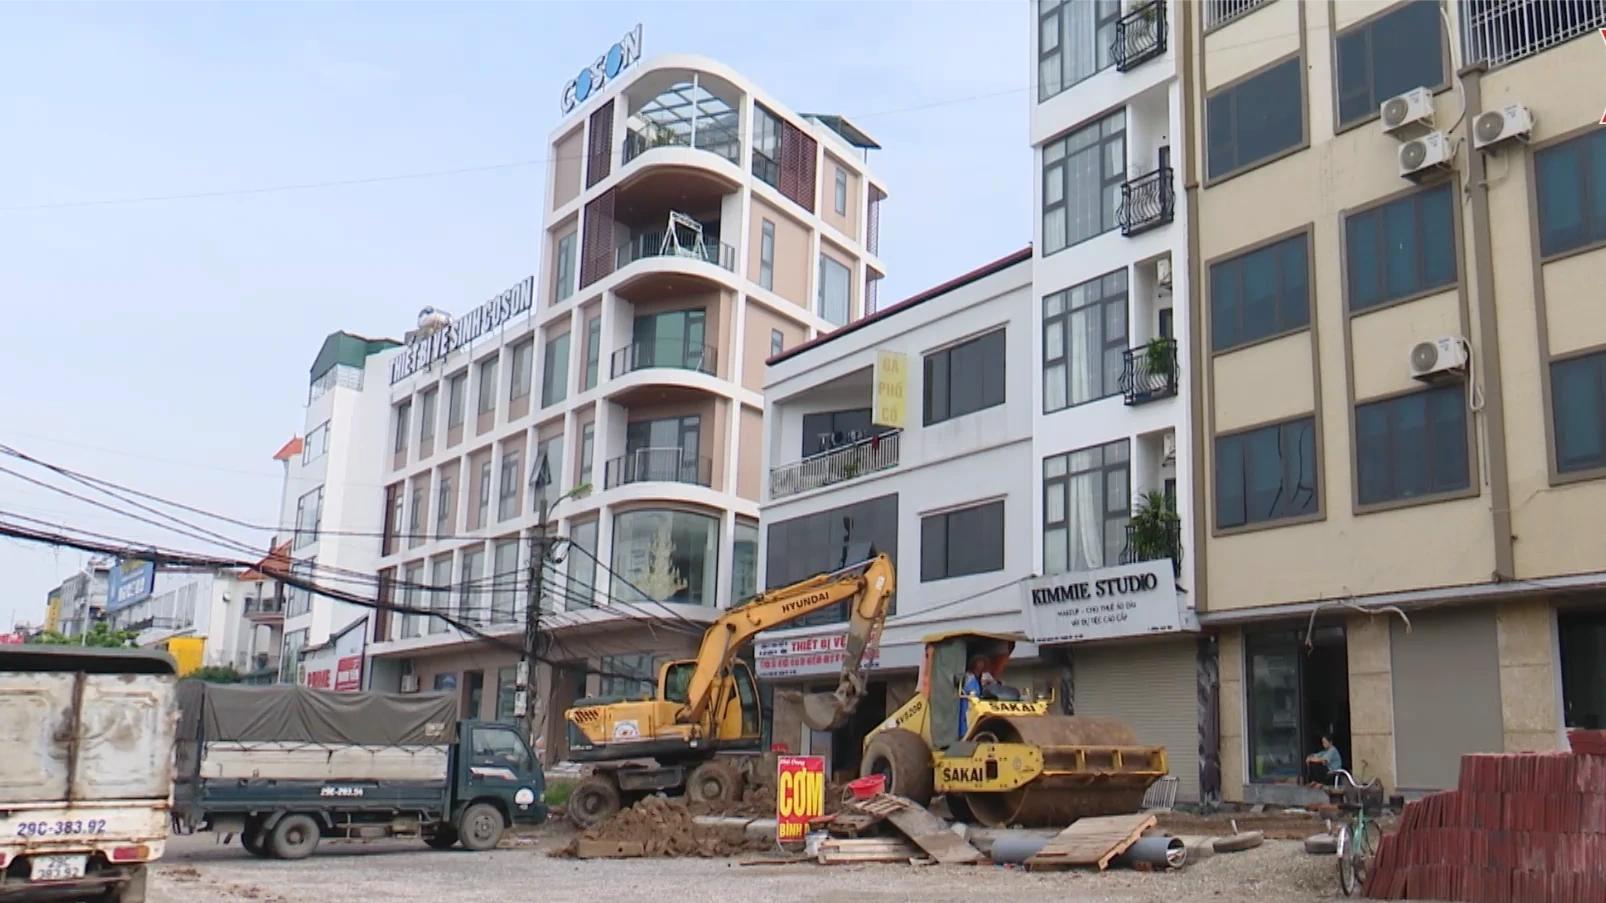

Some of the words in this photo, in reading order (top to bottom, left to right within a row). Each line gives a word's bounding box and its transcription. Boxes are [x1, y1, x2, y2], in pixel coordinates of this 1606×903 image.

[561, 23, 642, 114] COSON
[450, 305, 482, 351] SINH
[481, 275, 534, 332] COSON
[781, 591, 829, 613] HYUNDAI
[1032, 581, 1091, 606] KIMMIE
[1095, 572, 1158, 598] STUDIO
[989, 702, 1036, 712] SAKAI
[943, 767, 983, 782] SAKAI
[780, 767, 823, 817] CƠM
[17, 819, 106, 836] 29C-383.92
